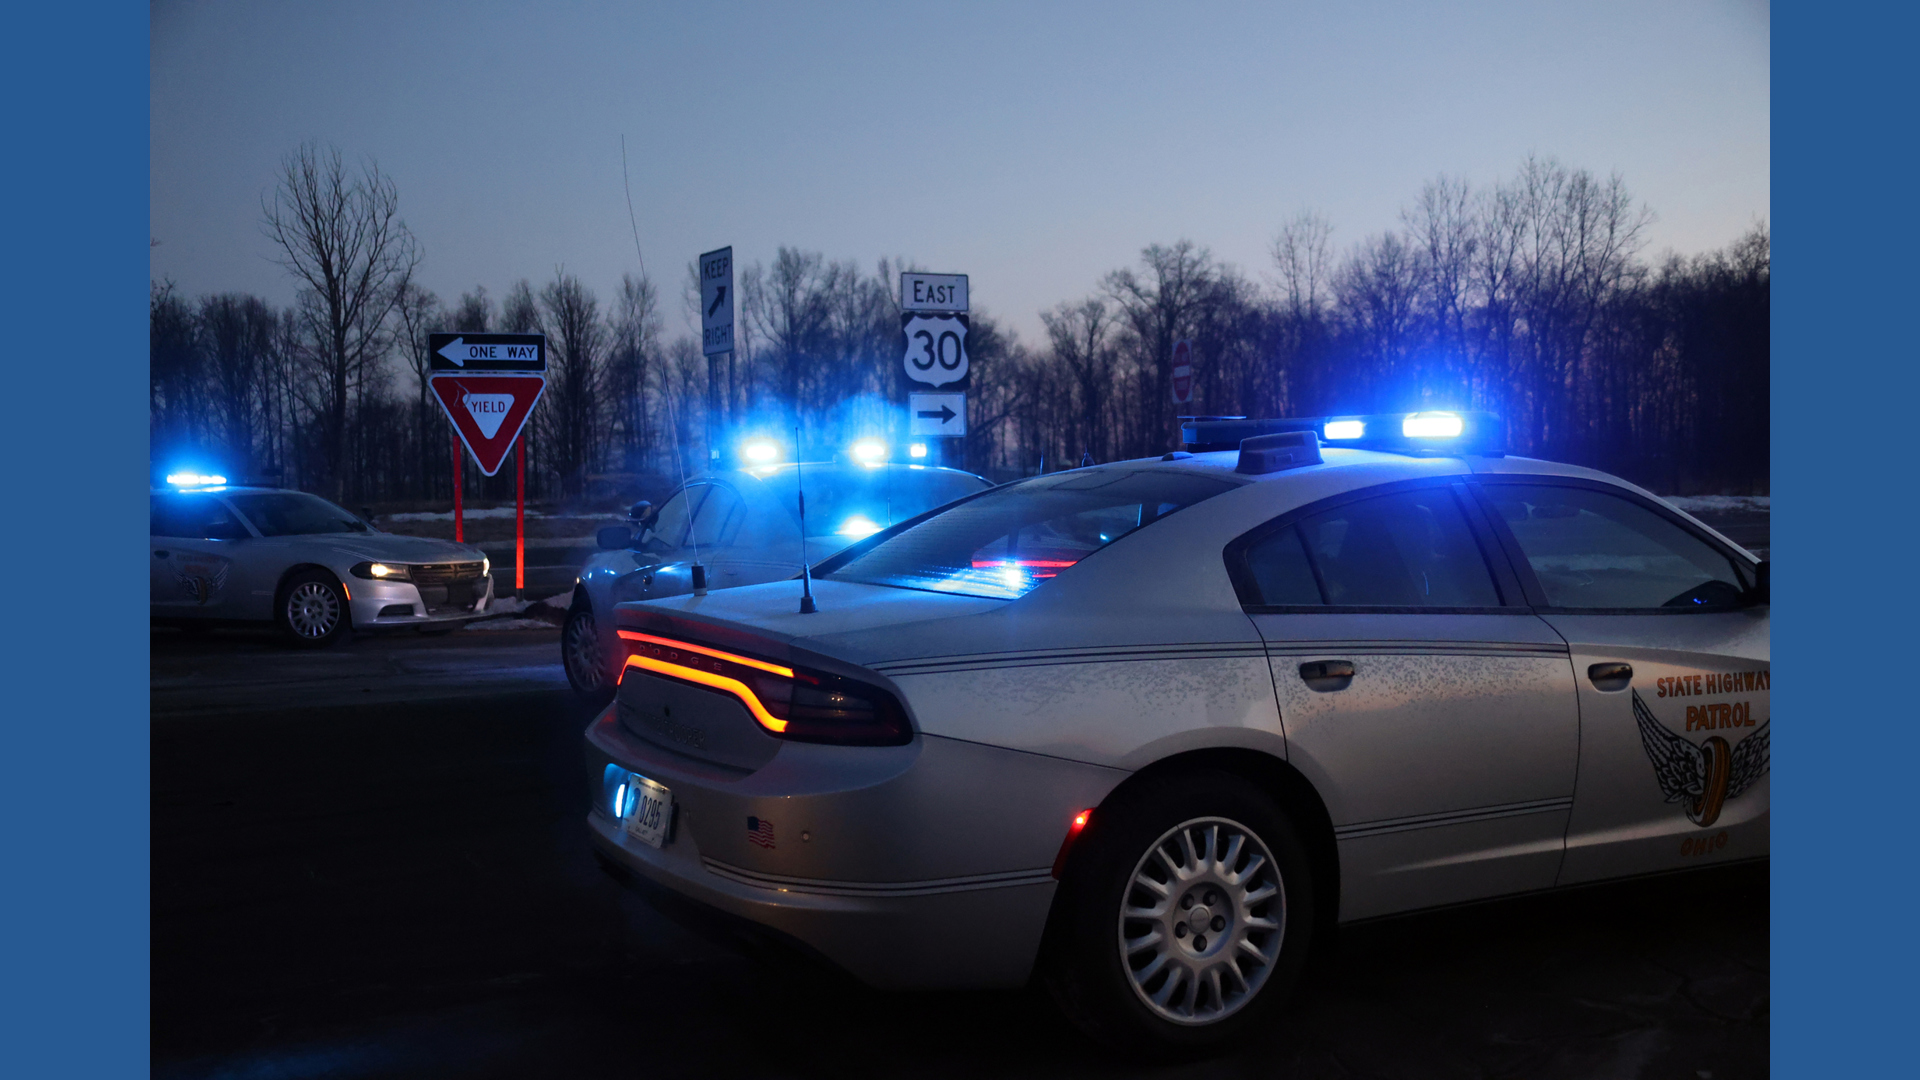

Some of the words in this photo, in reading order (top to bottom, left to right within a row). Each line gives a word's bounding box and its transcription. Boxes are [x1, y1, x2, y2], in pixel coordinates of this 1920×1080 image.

[704, 257, 729, 281] KEEP
[913, 280, 955, 304] EAST
[704, 324, 732, 347] RIGHT
[469, 346, 497, 358] ONE
[507, 346, 535, 359] WAY
[912, 329, 962, 371] 30
[471, 401, 506, 413] YIELD
[639, 644, 722, 671] DODGE
[1657, 675, 1702, 698] STATE
[1705, 670, 1770, 694] HIGHWAY
[1686, 702, 1756, 732] PATROL
[639, 795, 663, 830] 0295
[1680, 831, 1729, 857] OHIO
